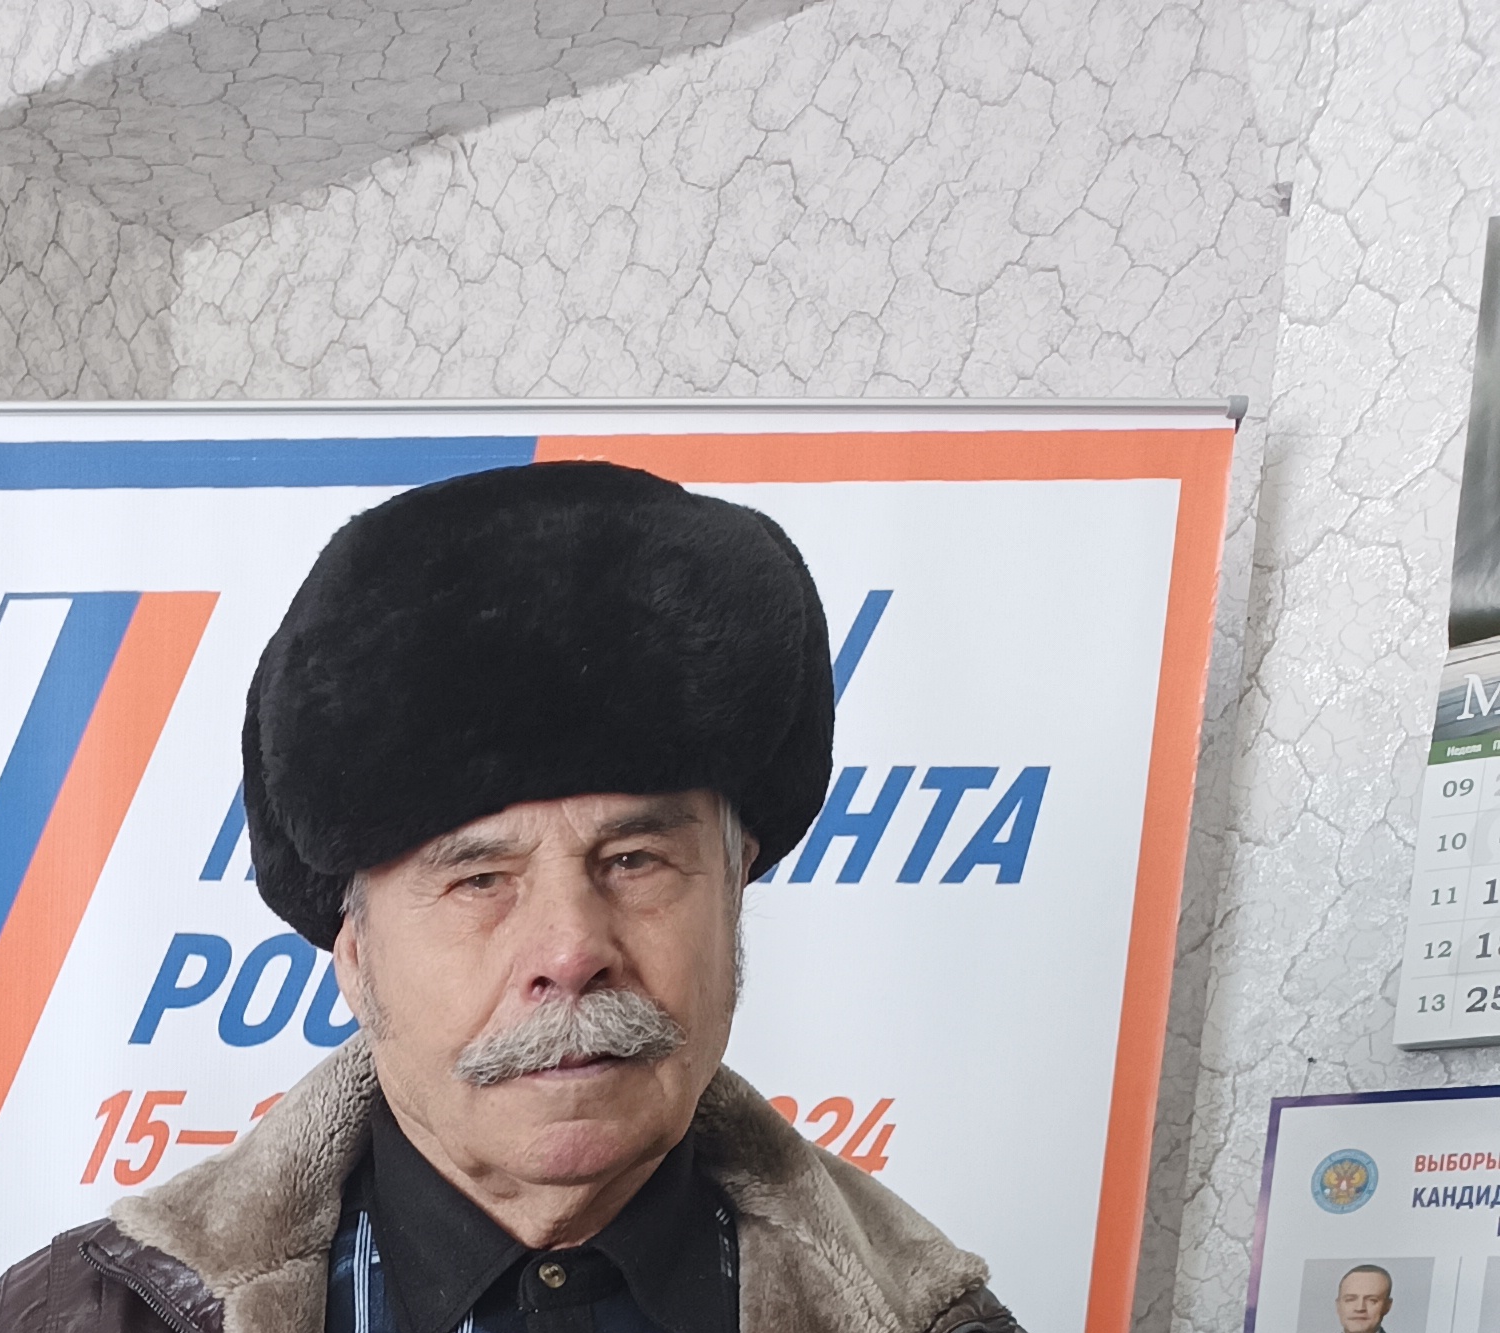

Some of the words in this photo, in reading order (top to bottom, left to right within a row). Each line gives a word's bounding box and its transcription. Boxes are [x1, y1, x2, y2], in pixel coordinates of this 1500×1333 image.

[1442, 778, 1474, 798] 09
[1437, 832, 1467, 852] 10
[1431, 886, 1457, 906] 11
[1423, 940, 1452, 959] 12
[1417, 994, 1446, 1013] 13
